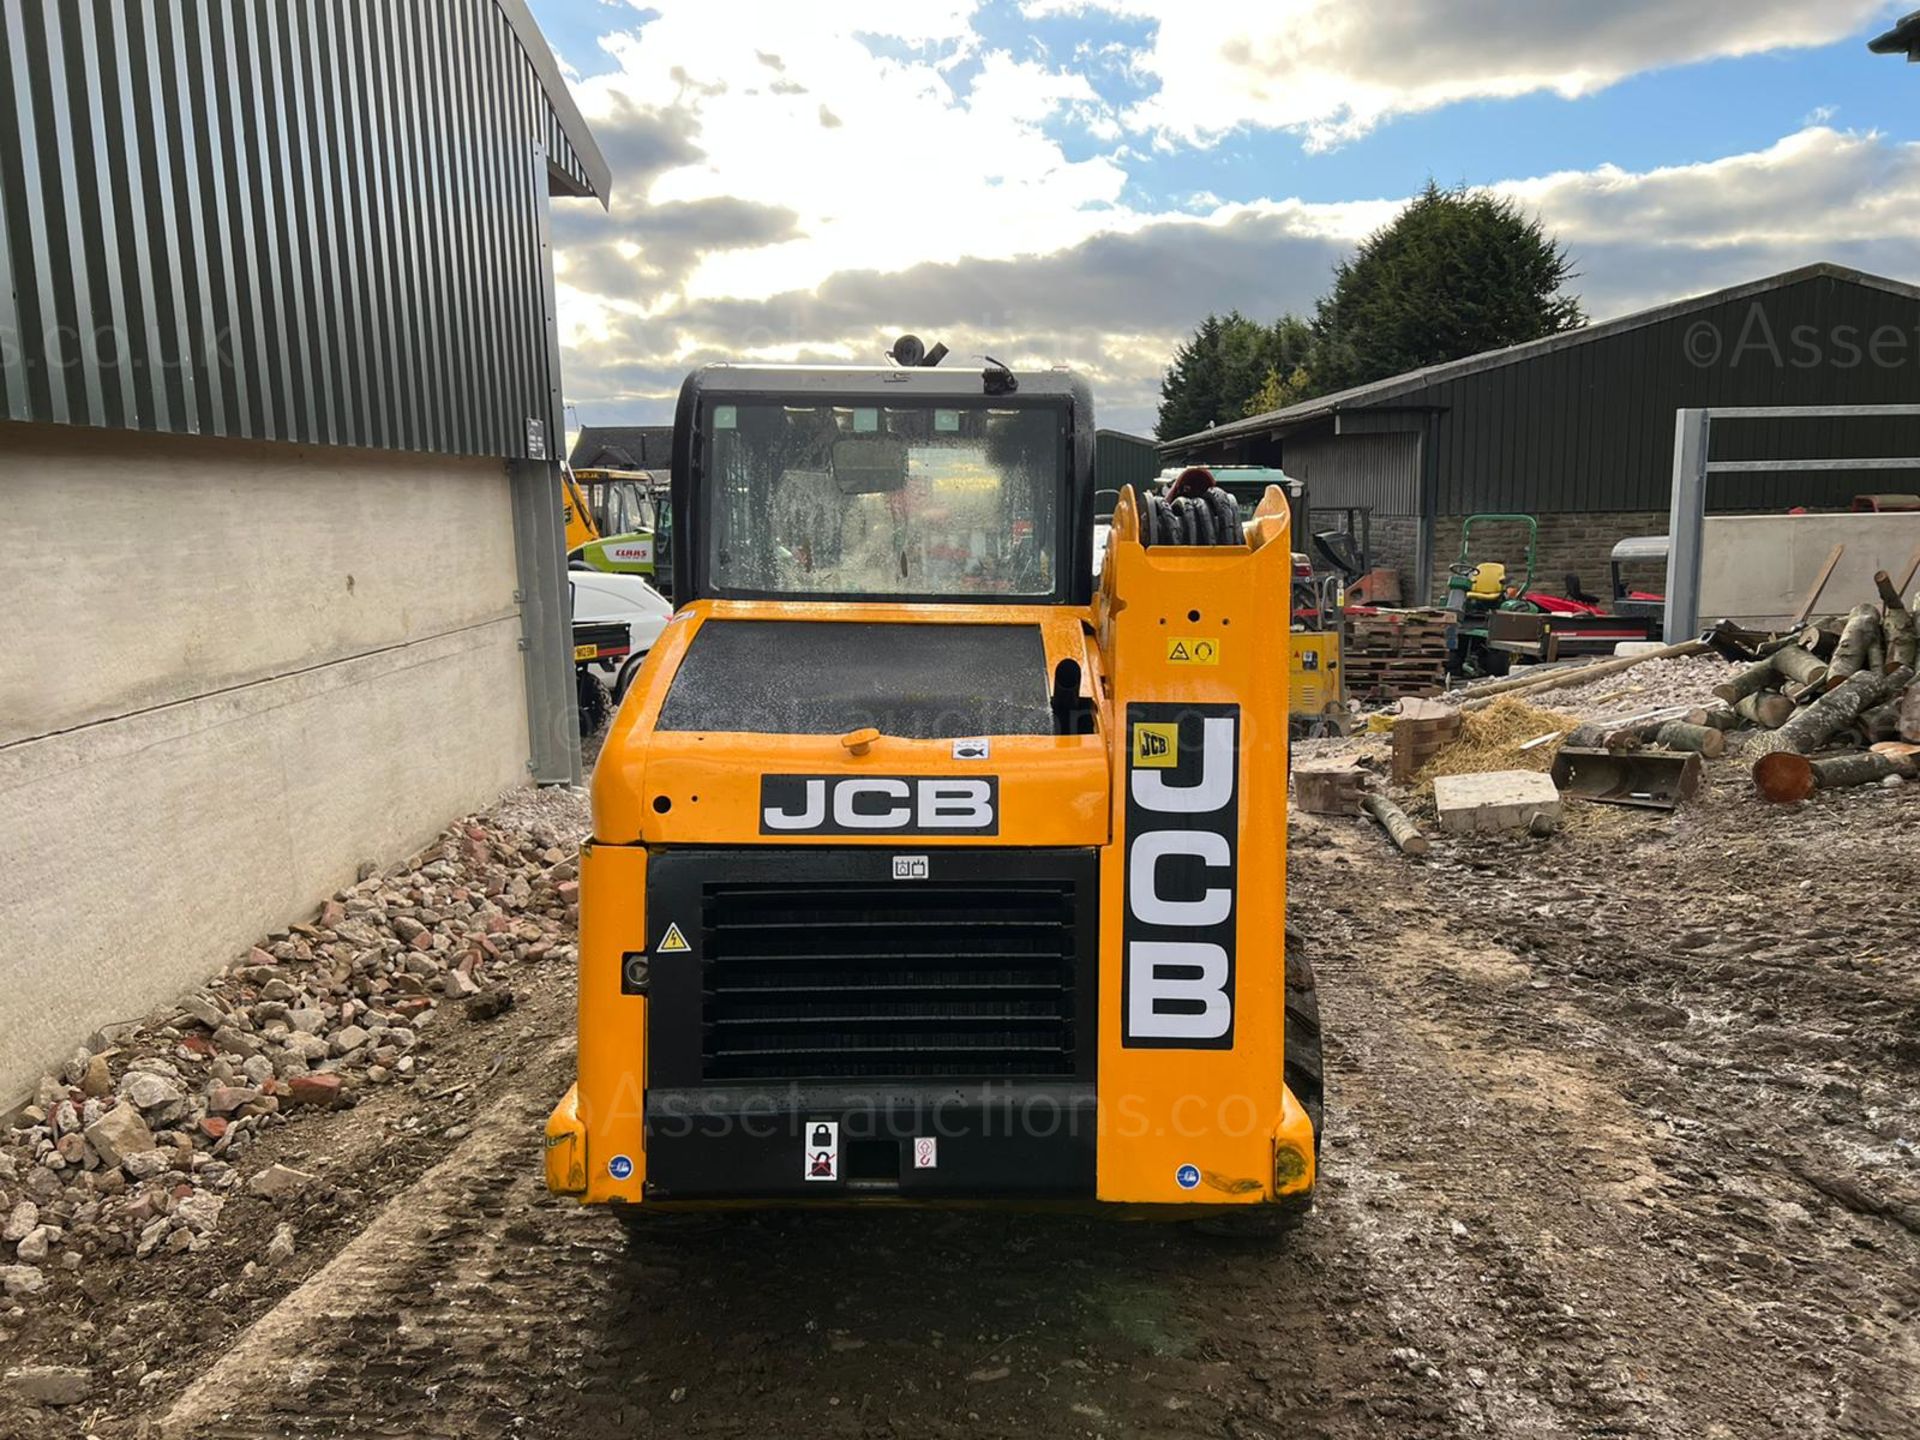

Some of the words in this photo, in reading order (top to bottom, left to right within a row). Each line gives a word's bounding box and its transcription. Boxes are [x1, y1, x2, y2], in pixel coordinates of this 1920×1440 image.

[615, 549, 647, 557] CLAAS
[1141, 731, 1167, 757] JCB
[763, 778, 994, 830] JCB
[1129, 717, 1236, 1040] JCB
